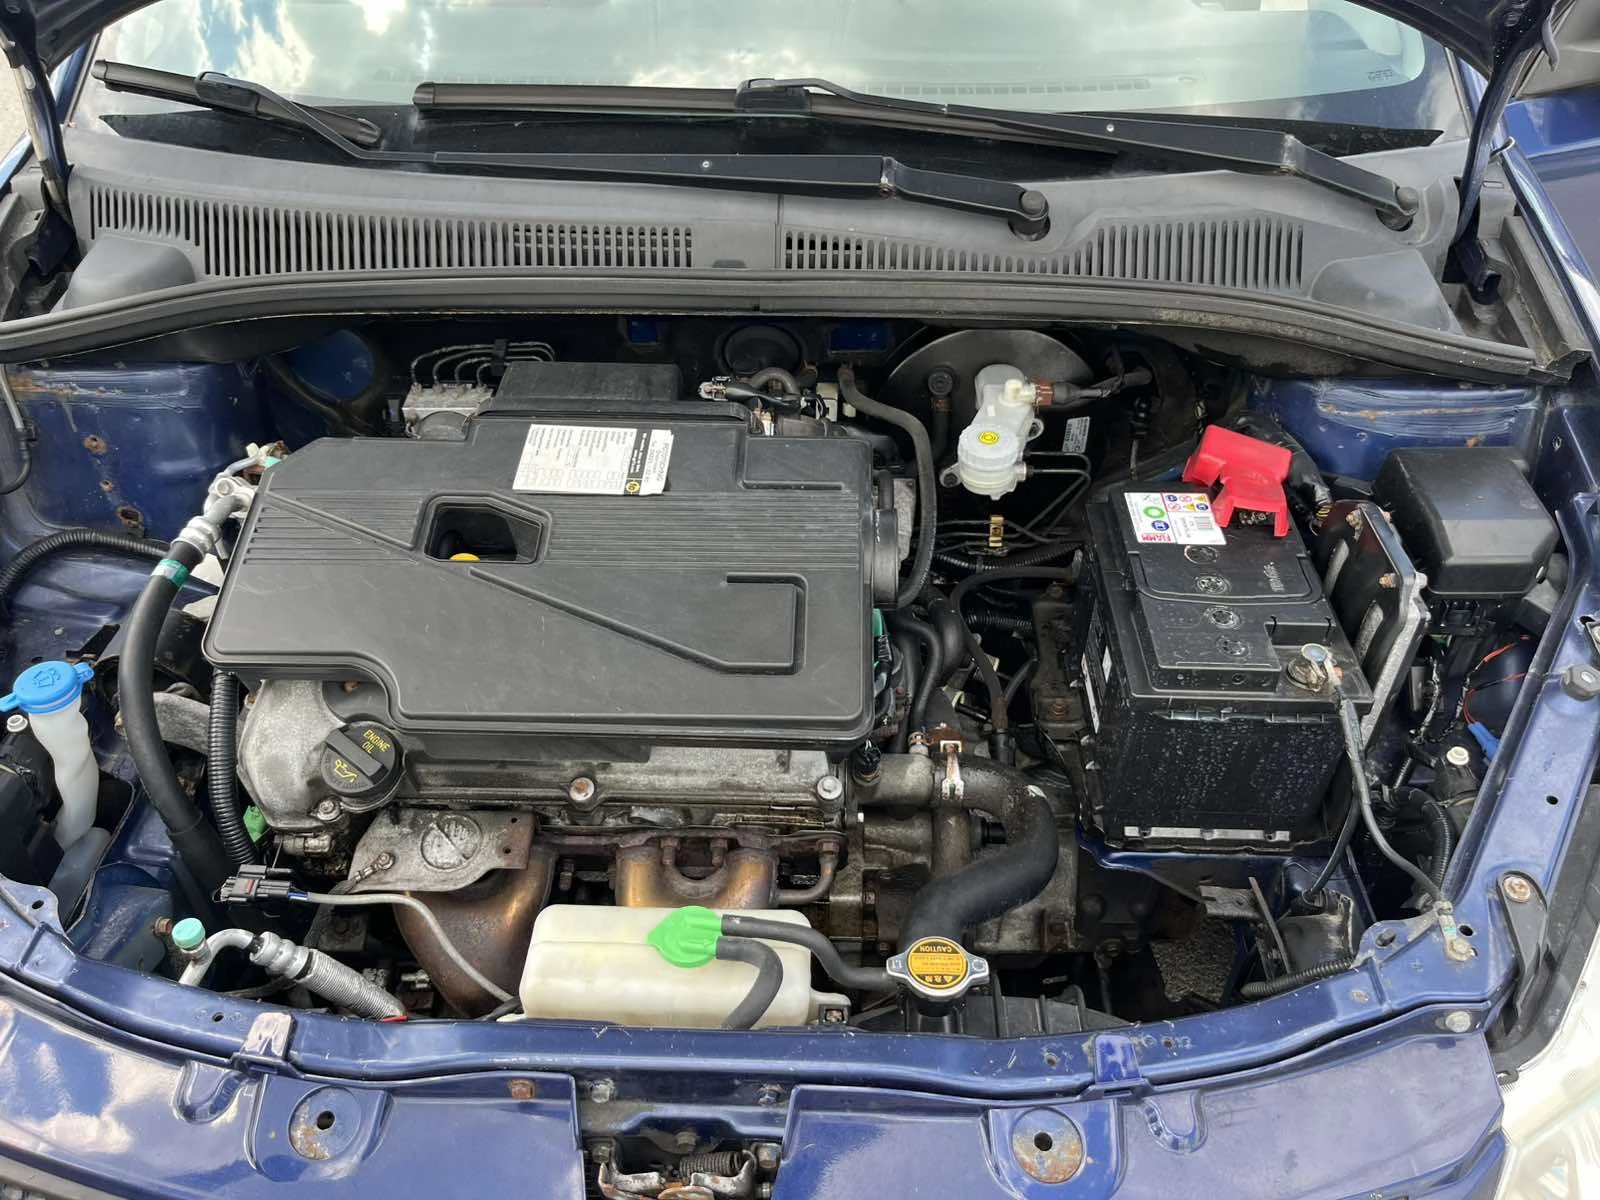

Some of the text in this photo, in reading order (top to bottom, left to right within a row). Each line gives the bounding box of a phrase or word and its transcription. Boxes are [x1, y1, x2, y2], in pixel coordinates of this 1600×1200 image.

[363, 729, 391, 752] ENGINE
[362, 742, 375, 754] OIL
[919, 945, 953, 953] CAUTION
